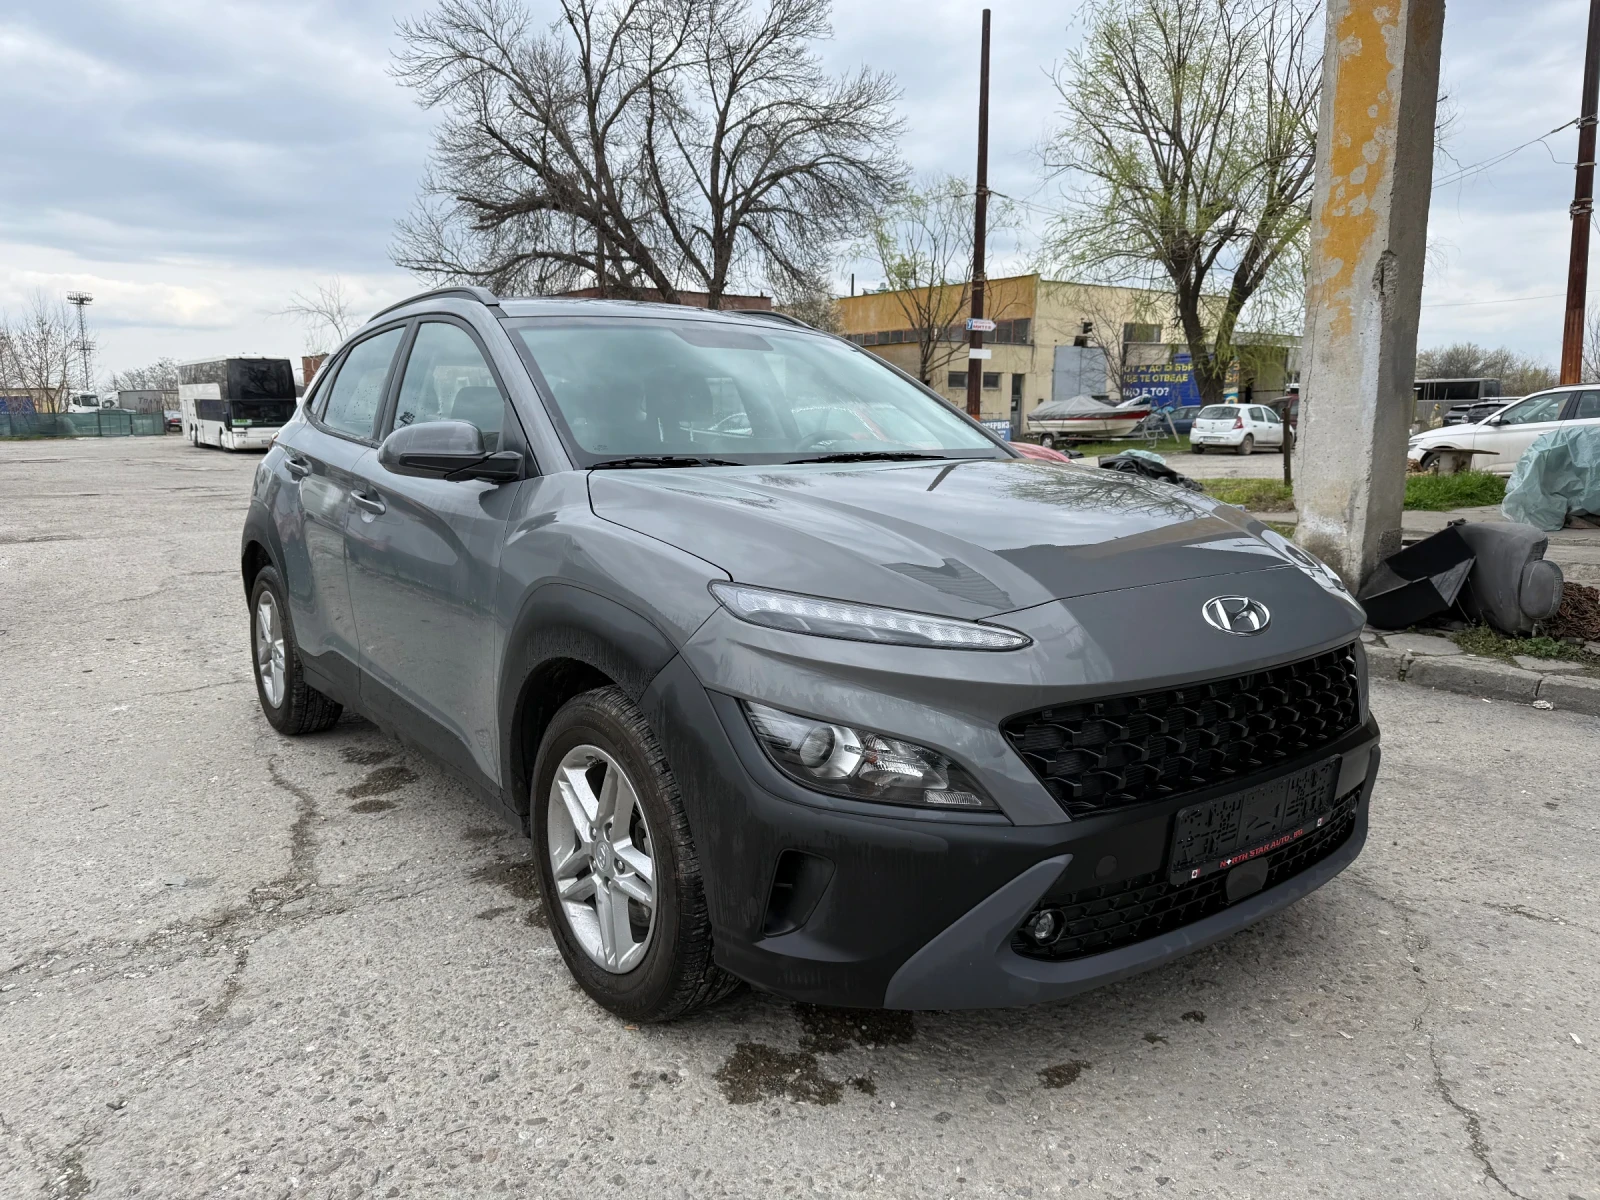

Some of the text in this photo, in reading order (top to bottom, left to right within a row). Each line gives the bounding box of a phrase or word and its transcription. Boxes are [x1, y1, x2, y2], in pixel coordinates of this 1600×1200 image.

[1140, 374, 1150, 383] ТЕ
[1152, 373, 1188, 384] ОТВЕДЕ
[1150, 387, 1169, 396] ТО?
[1249, 844, 1270, 857] STAR
